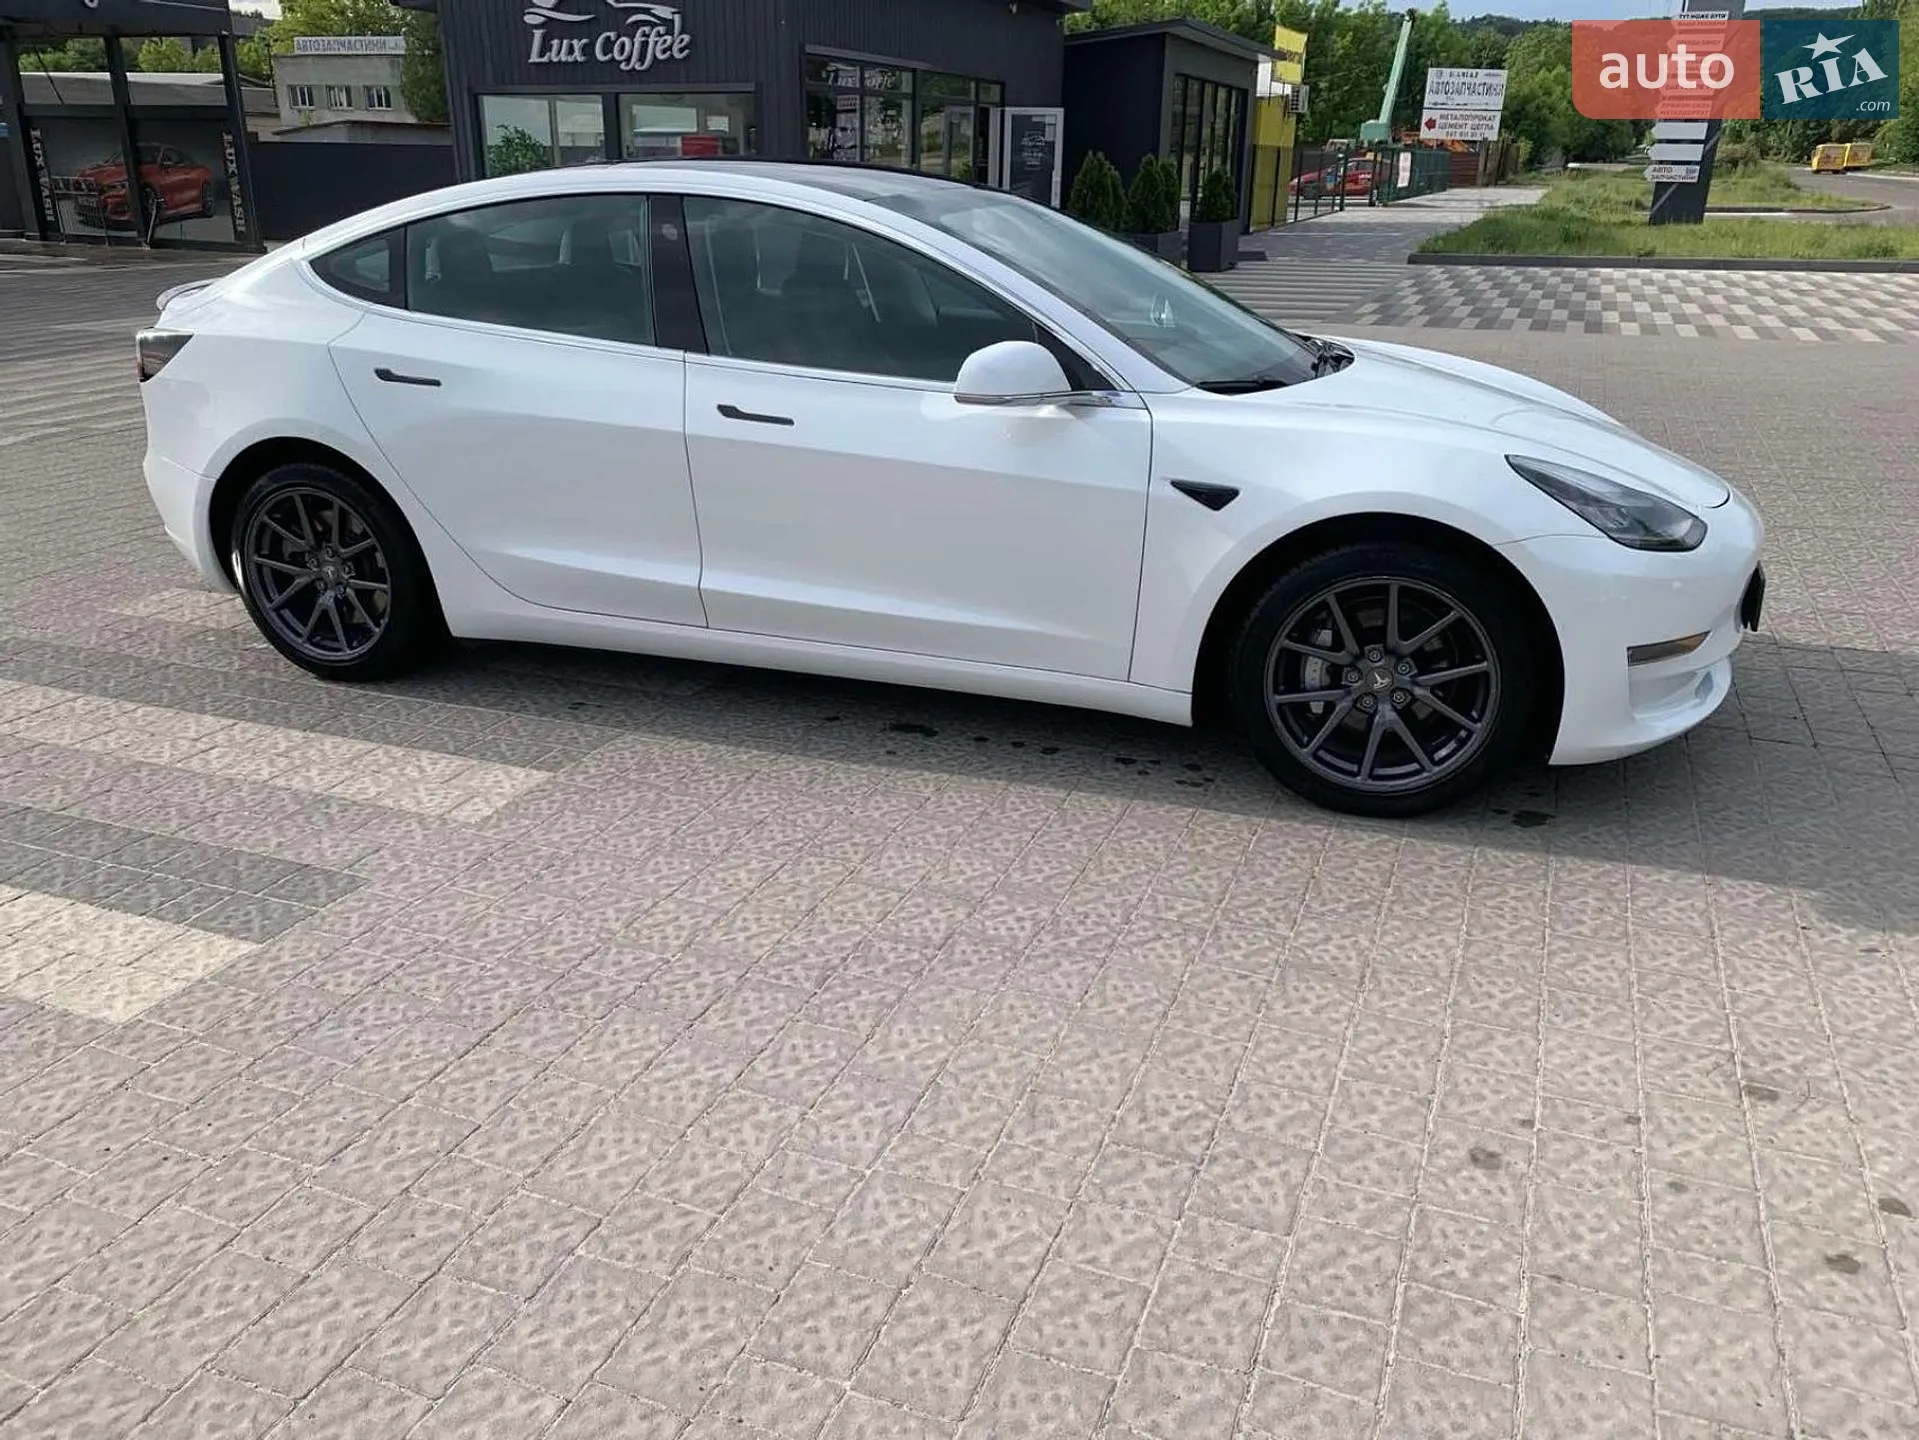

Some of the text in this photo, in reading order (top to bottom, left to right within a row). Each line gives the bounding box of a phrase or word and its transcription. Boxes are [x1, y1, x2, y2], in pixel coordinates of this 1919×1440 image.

[528, 26, 691, 71] Lux Coffee
[1440, 113, 1496, 121] МЕТАЛОПРОКАТ
[1438, 121, 1468, 129] ЦЕМЕНТ
